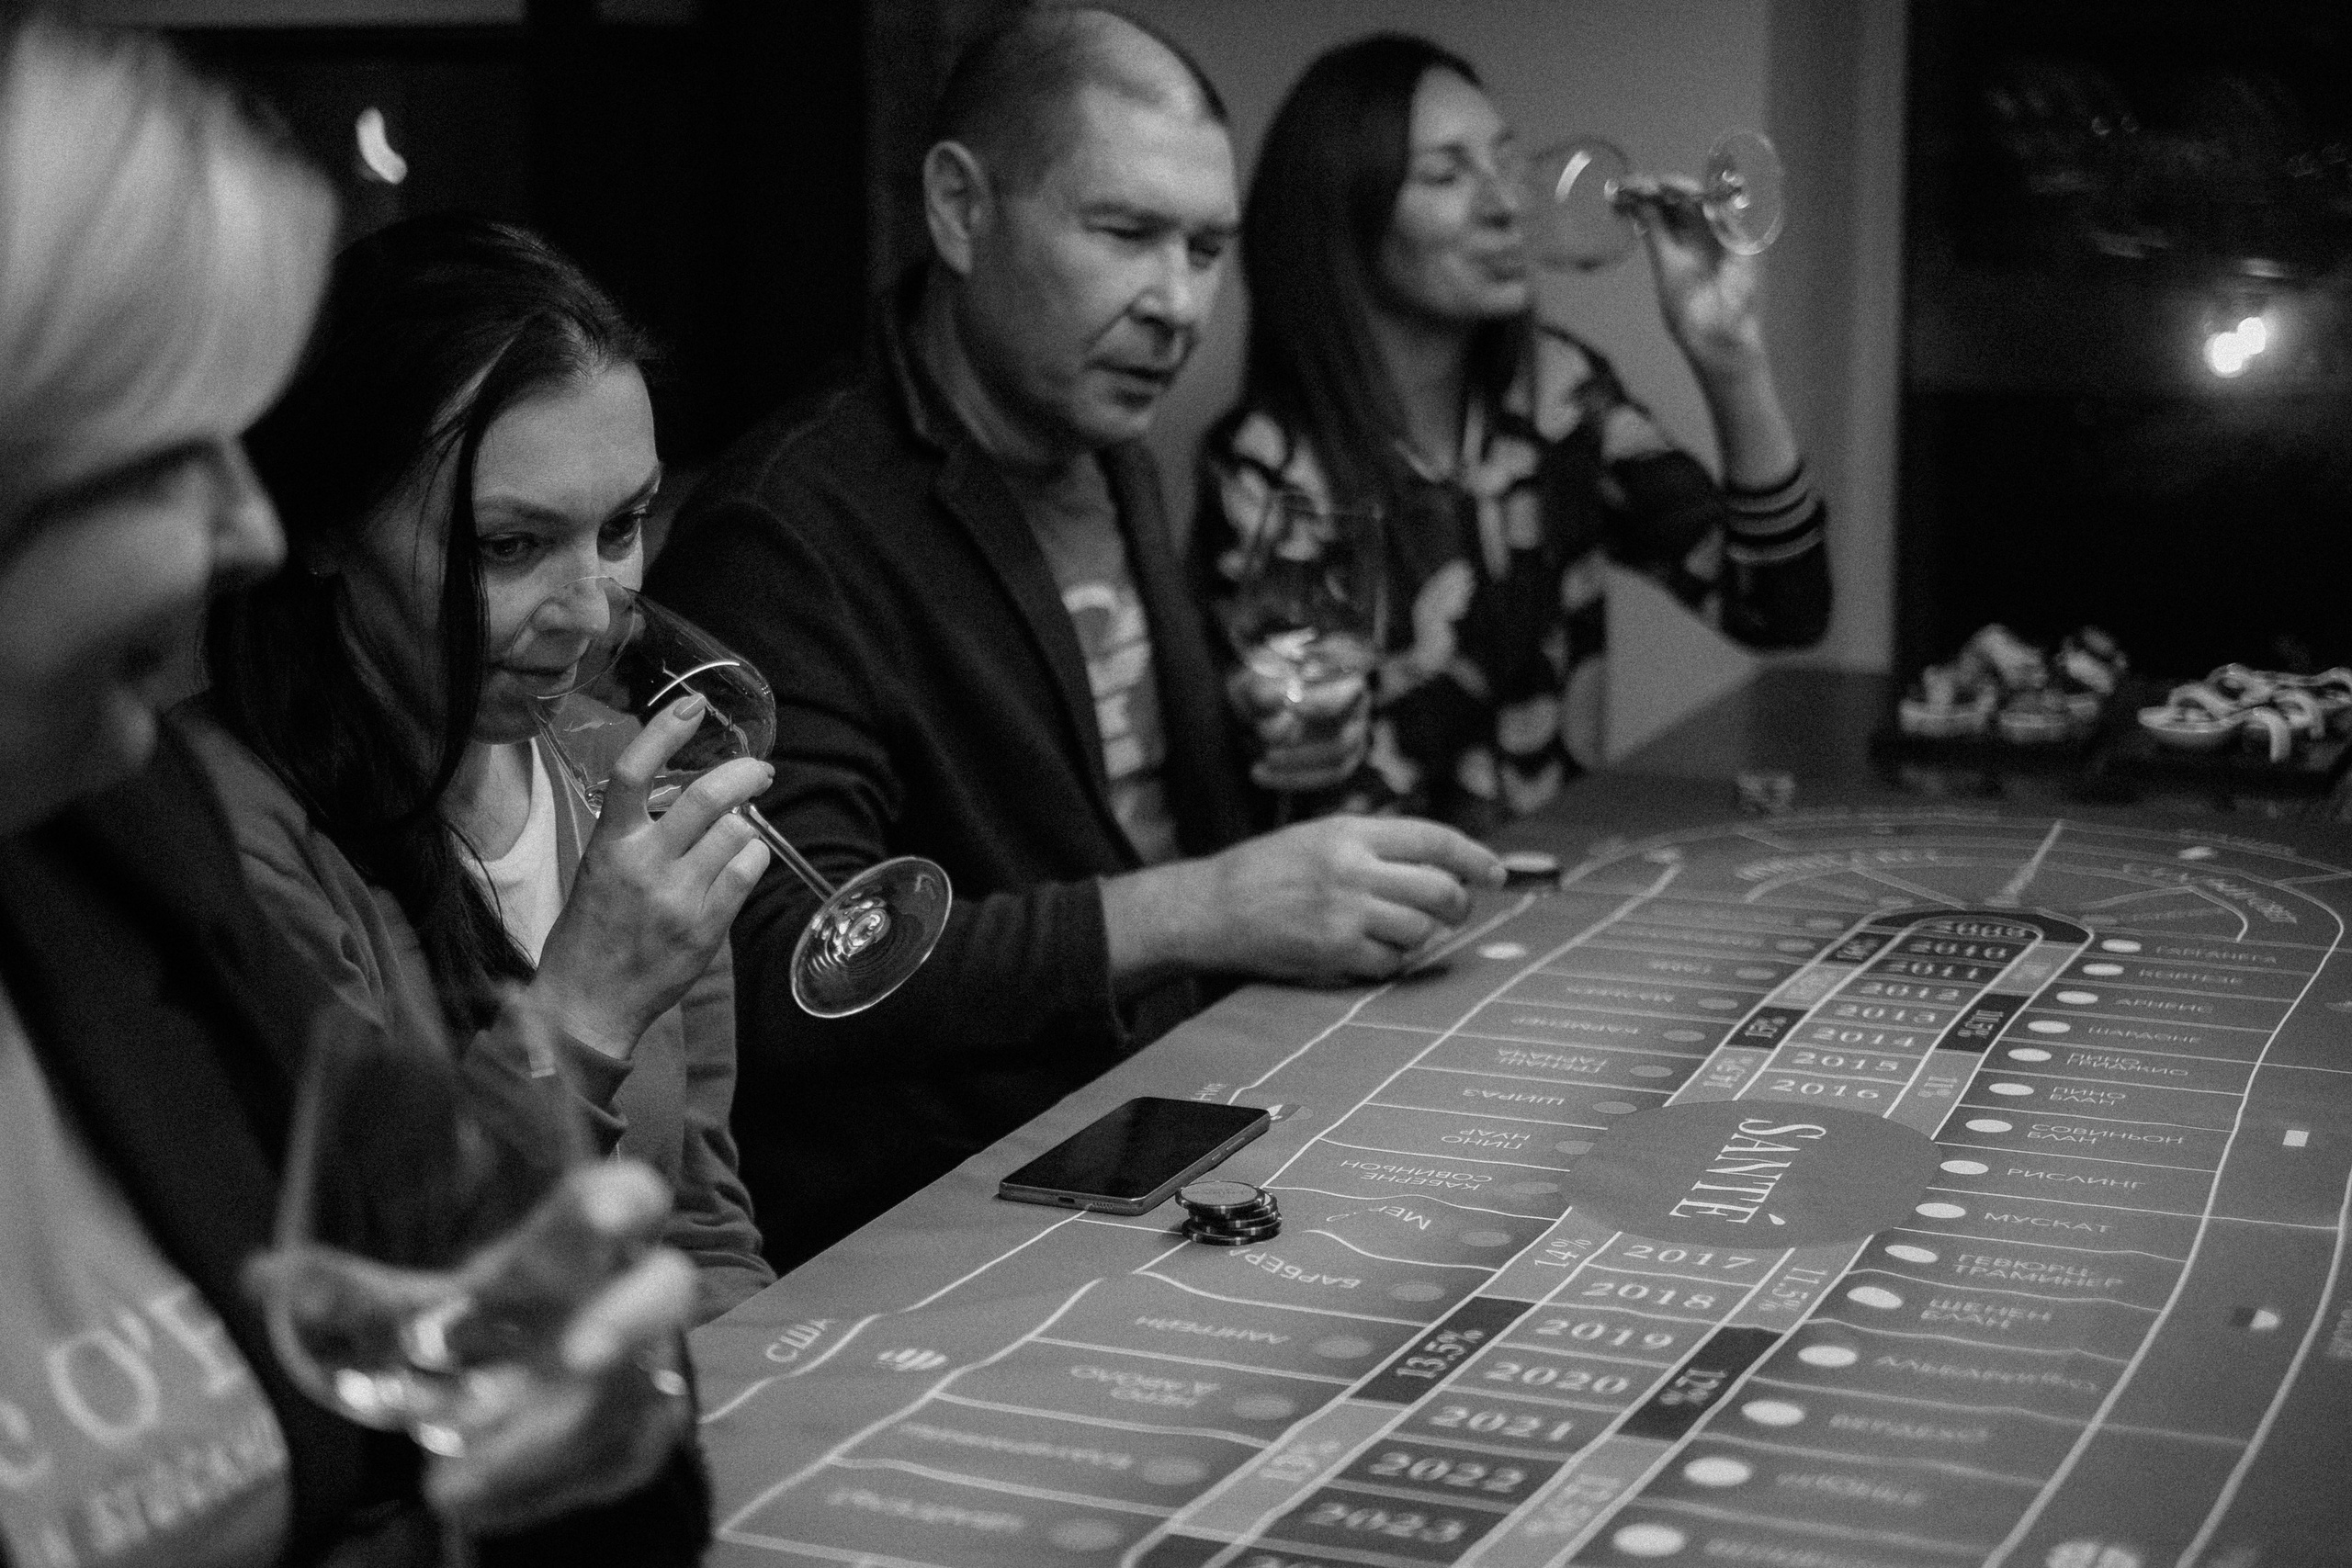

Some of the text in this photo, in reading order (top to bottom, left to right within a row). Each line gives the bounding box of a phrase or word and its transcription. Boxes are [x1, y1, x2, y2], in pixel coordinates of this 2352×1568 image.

[1835, 1005, 1936, 1023] 2013
[1812, 1027, 1916, 1048] 2014
[1792, 1051, 1899, 1073] 2015
[2067, 1051, 2142, 1066] ПИНО
[1461, 1087, 1566, 1107] ШИРАЗ
[1770, 1078, 1880, 1100] 2016
[2049, 1094, 2117, 1107] БЛАН
[2052, 1085, 2128, 1101] ПИНО
[1440, 1134, 1524, 1151] ПИНО
[1458, 1127, 1532, 1142] НУАР
[2026, 1131, 2099, 1146] БЛАН
[2031, 1122, 2186, 1145] СОВИНЬОН
[1339, 1158, 1495, 1184] СОВИНЬОН
[1359, 1171, 1482, 1192] КАБЕРНЕ
[2007, 1167, 2147, 1191] РИСЛИНГ
[1984, 1212, 2114, 1235] МУСКАТ
[1533, 1235, 1594, 1269] 14%
[1623, 1244, 1758, 1270] 2017
[1227, 1247, 1363, 1290] БАРБЕРА
[1953, 1263, 2124, 1291] ТРАМИНЕР
[1581, 1280, 1716, 1312] 2018
[1758, 1264, 1828, 1314] 11.5%
[764, 1317, 837, 1364] США
[1534, 1318, 1674, 1350] 2019
[1395, 1327, 1486, 1381] 13.5%
[1484, 1359, 1630, 1395] 2020
[1429, 1404, 1574, 1443] 2021
[1368, 1451, 1529, 1495] 2022
[1304, 1500, 1470, 1546] 2023
